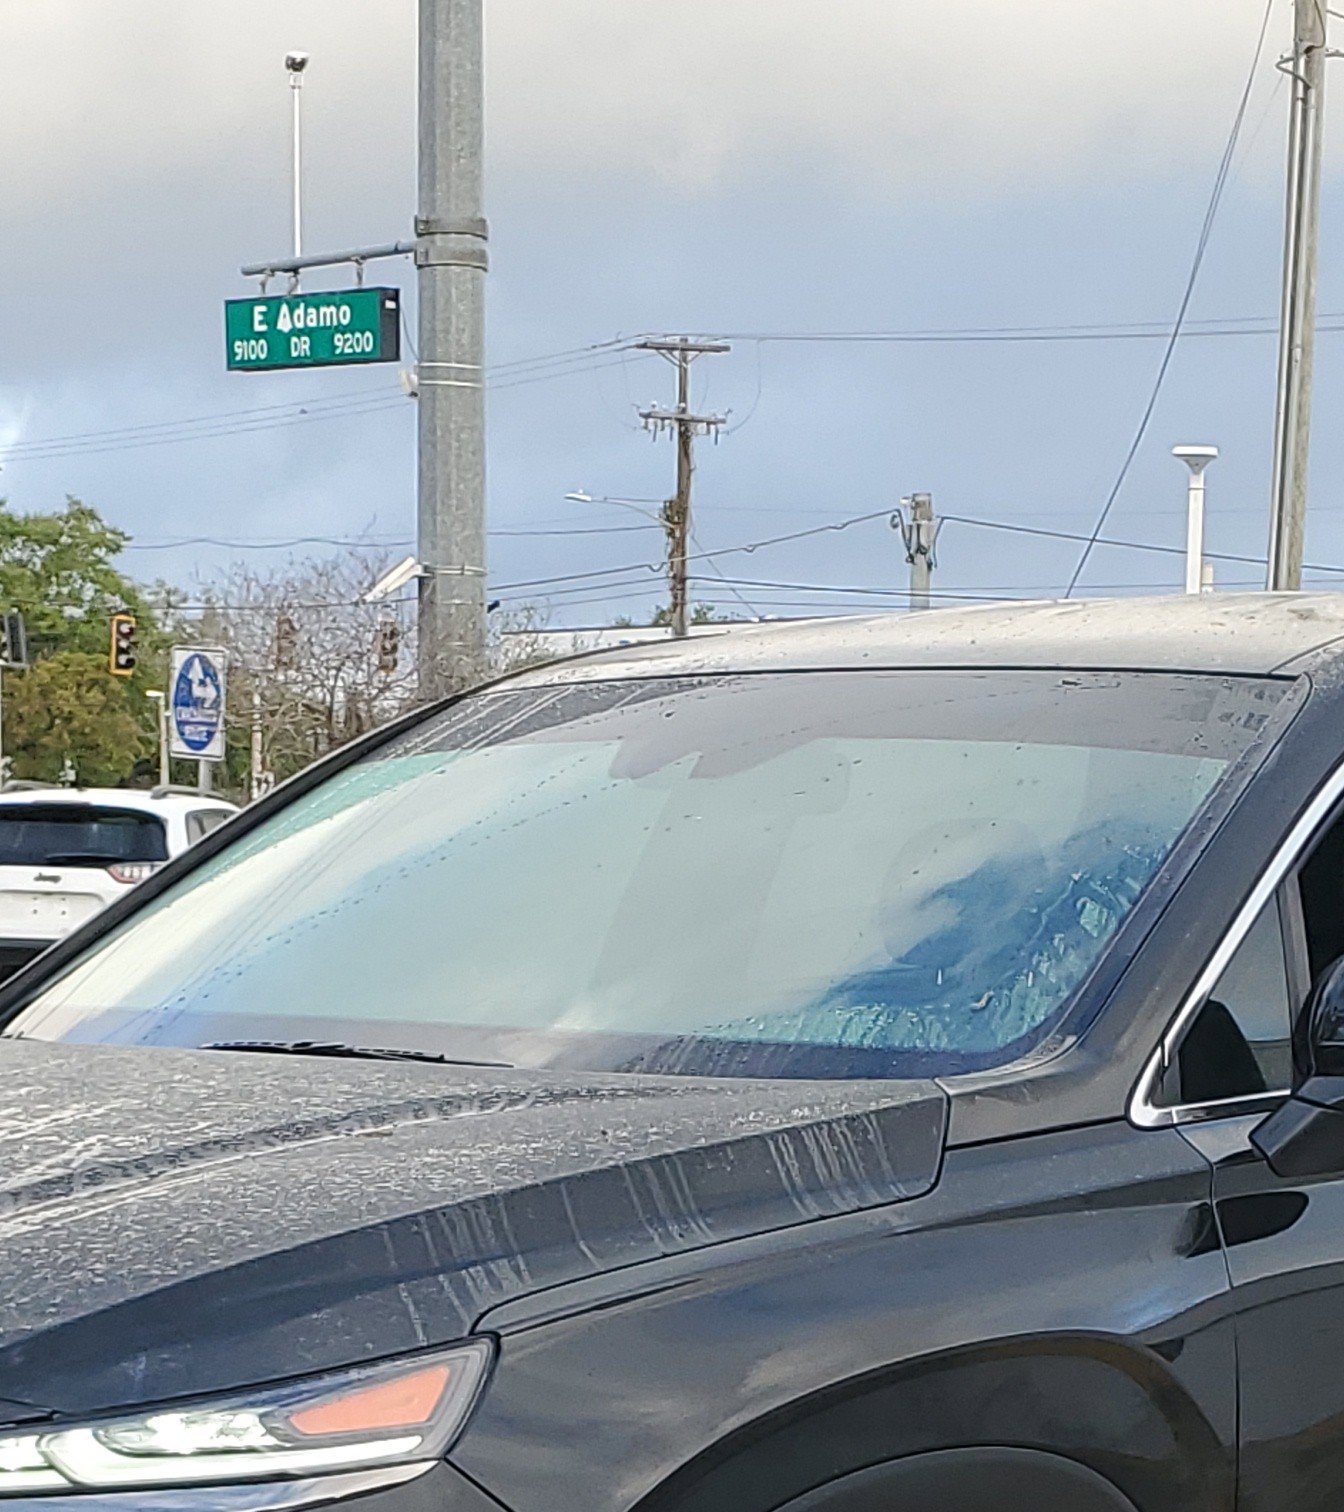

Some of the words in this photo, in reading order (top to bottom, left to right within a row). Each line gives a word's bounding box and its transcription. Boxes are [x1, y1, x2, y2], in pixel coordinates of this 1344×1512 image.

[253, 305, 268, 332] E
[276, 302, 351, 333] Adamo
[234, 338, 268, 361] 9100
[290, 336, 311, 358] DR
[333, 331, 374, 354] 9200
